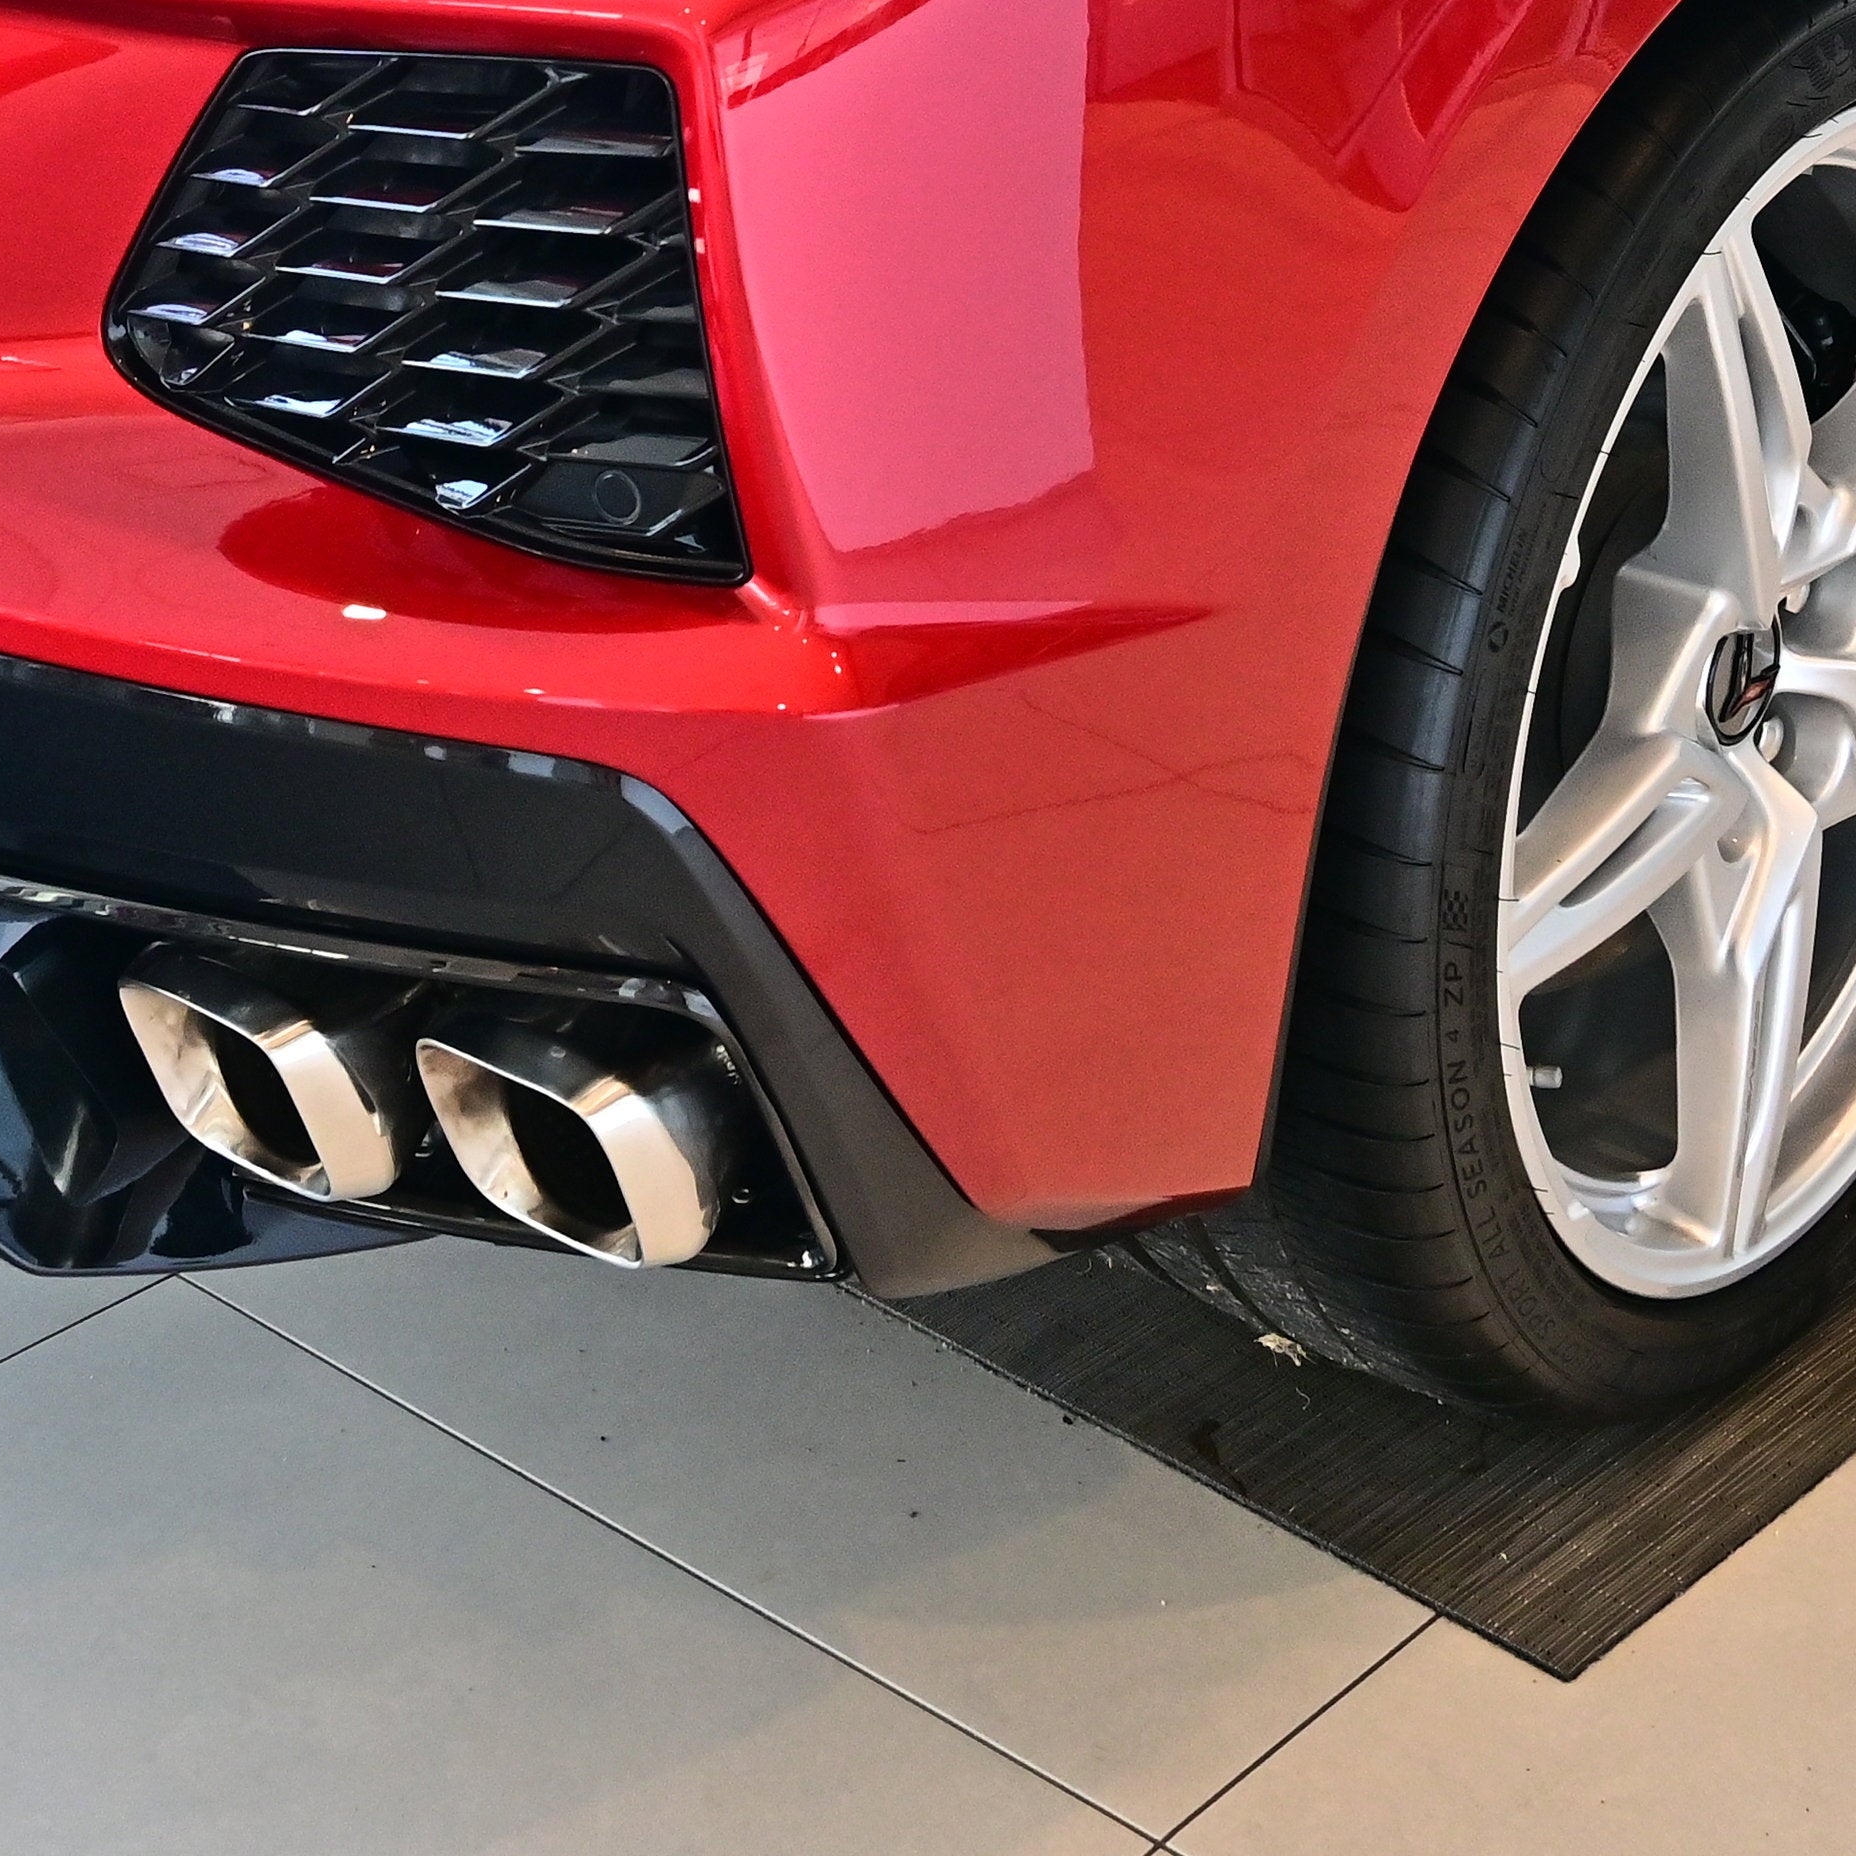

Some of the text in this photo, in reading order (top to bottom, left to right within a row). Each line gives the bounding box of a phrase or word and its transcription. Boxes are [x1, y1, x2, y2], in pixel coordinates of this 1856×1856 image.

[1444, 961, 1463, 1008] ZP
[1447, 1059, 1488, 1199] SEASON
[1477, 1205, 1510, 1260] ALL
